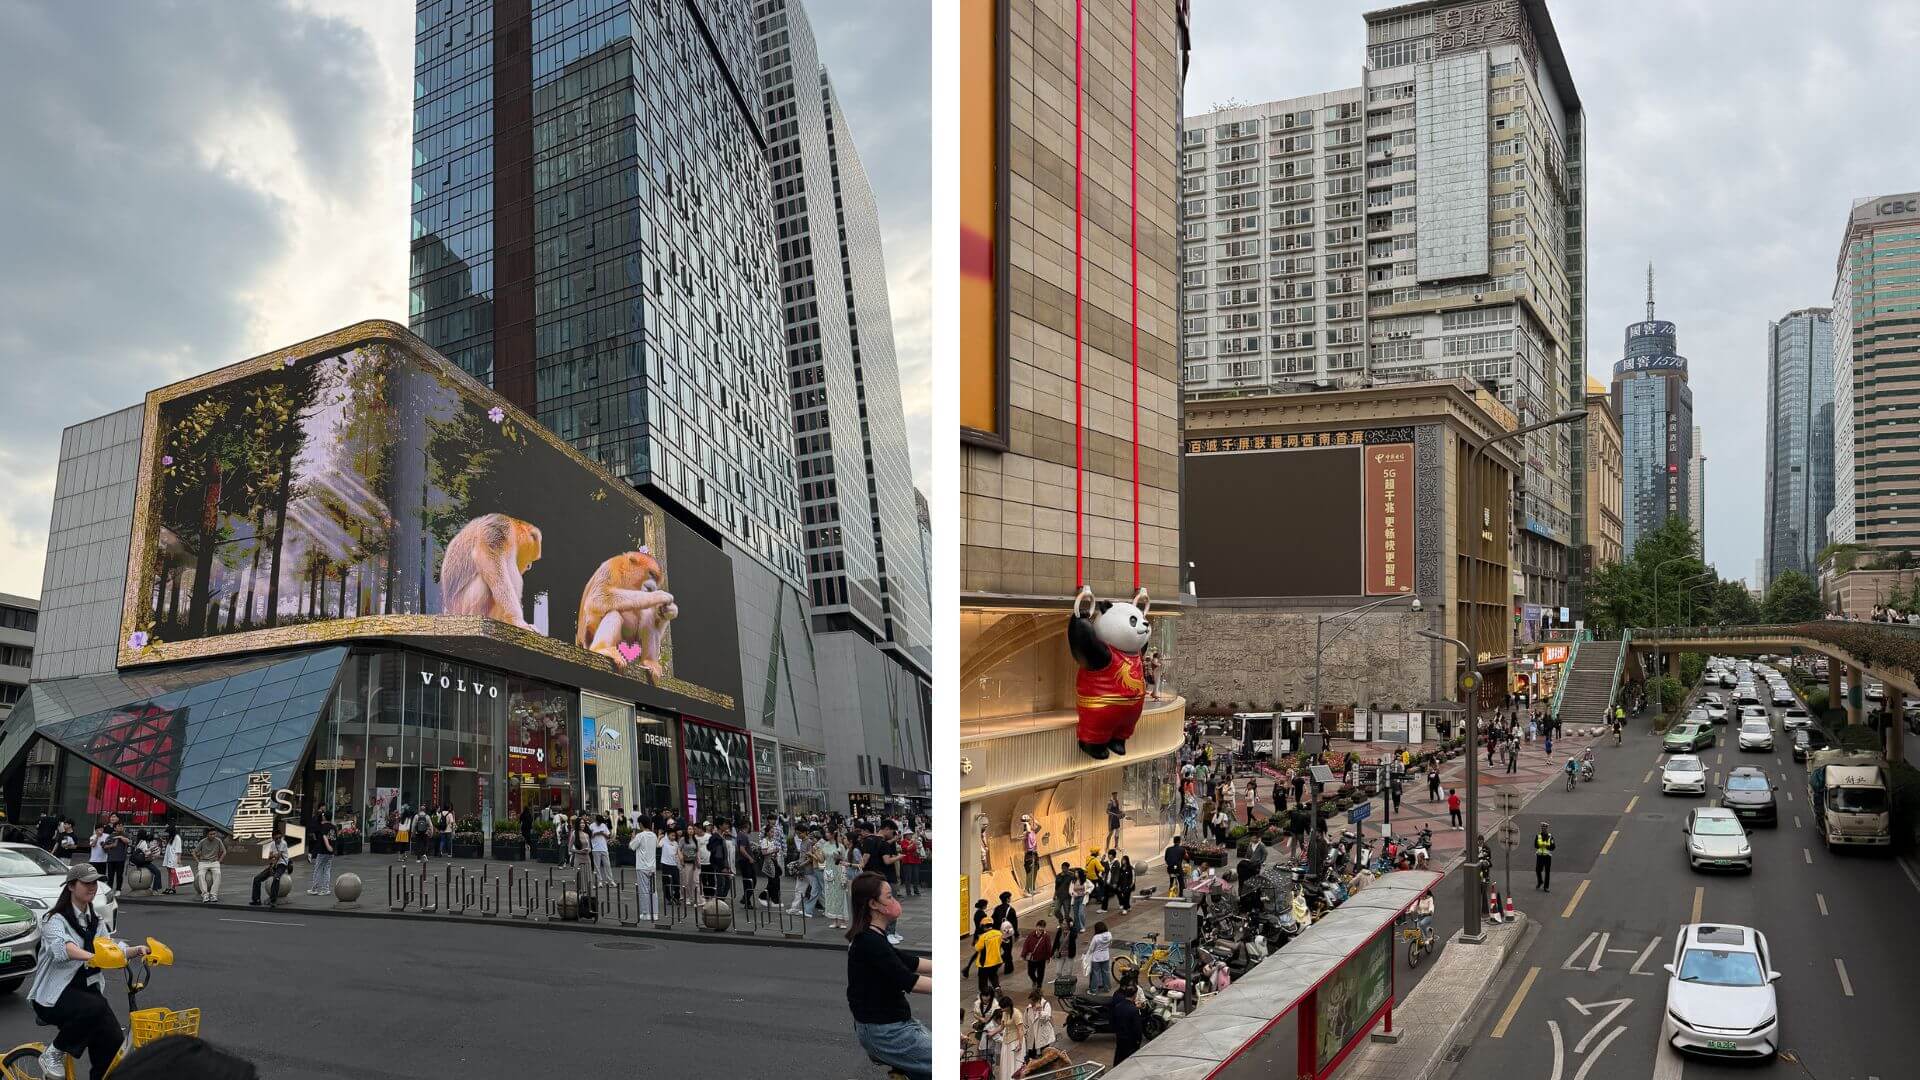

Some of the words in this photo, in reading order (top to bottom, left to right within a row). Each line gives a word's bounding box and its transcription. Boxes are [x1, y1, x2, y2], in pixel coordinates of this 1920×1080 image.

[1471, 2, 1507, 24] 春熙
[1440, 20, 1517, 49] 商汇广场
[1876, 200, 1917, 217] ICBC
[1190, 431, 1364, 453] 百城千屏联播网西南首屏
[420, 671, 498, 698] VOLVO
[645, 733, 673, 748] DREAME
[1845, 775, 1866, 785] 解放
